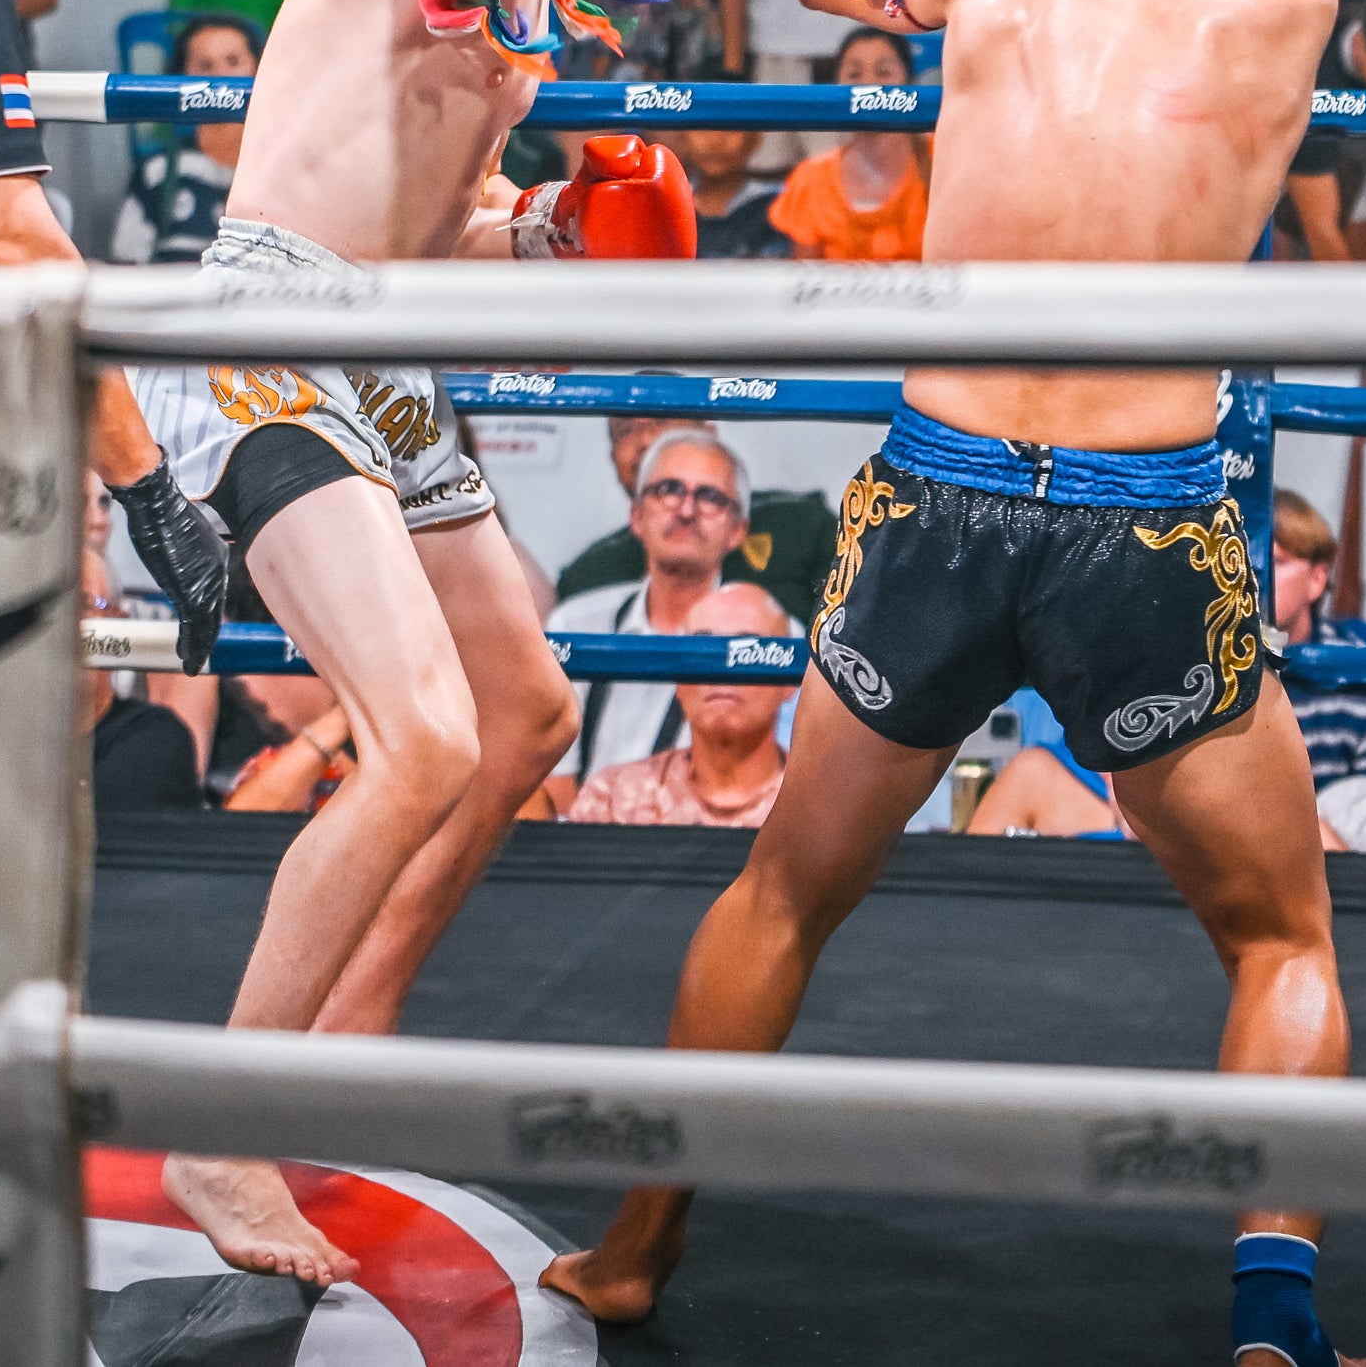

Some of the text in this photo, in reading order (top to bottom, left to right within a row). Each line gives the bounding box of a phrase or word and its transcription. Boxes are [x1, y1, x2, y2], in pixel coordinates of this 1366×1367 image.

[179, 82, 244, 112] Fairtex
[625, 84, 692, 112] Fairtex
[849, 86, 918, 113] Fairtex
[489, 372, 556, 395] Fairtex
[709, 377, 777, 401] Fairtex
[726, 639, 794, 667] Fairtex
